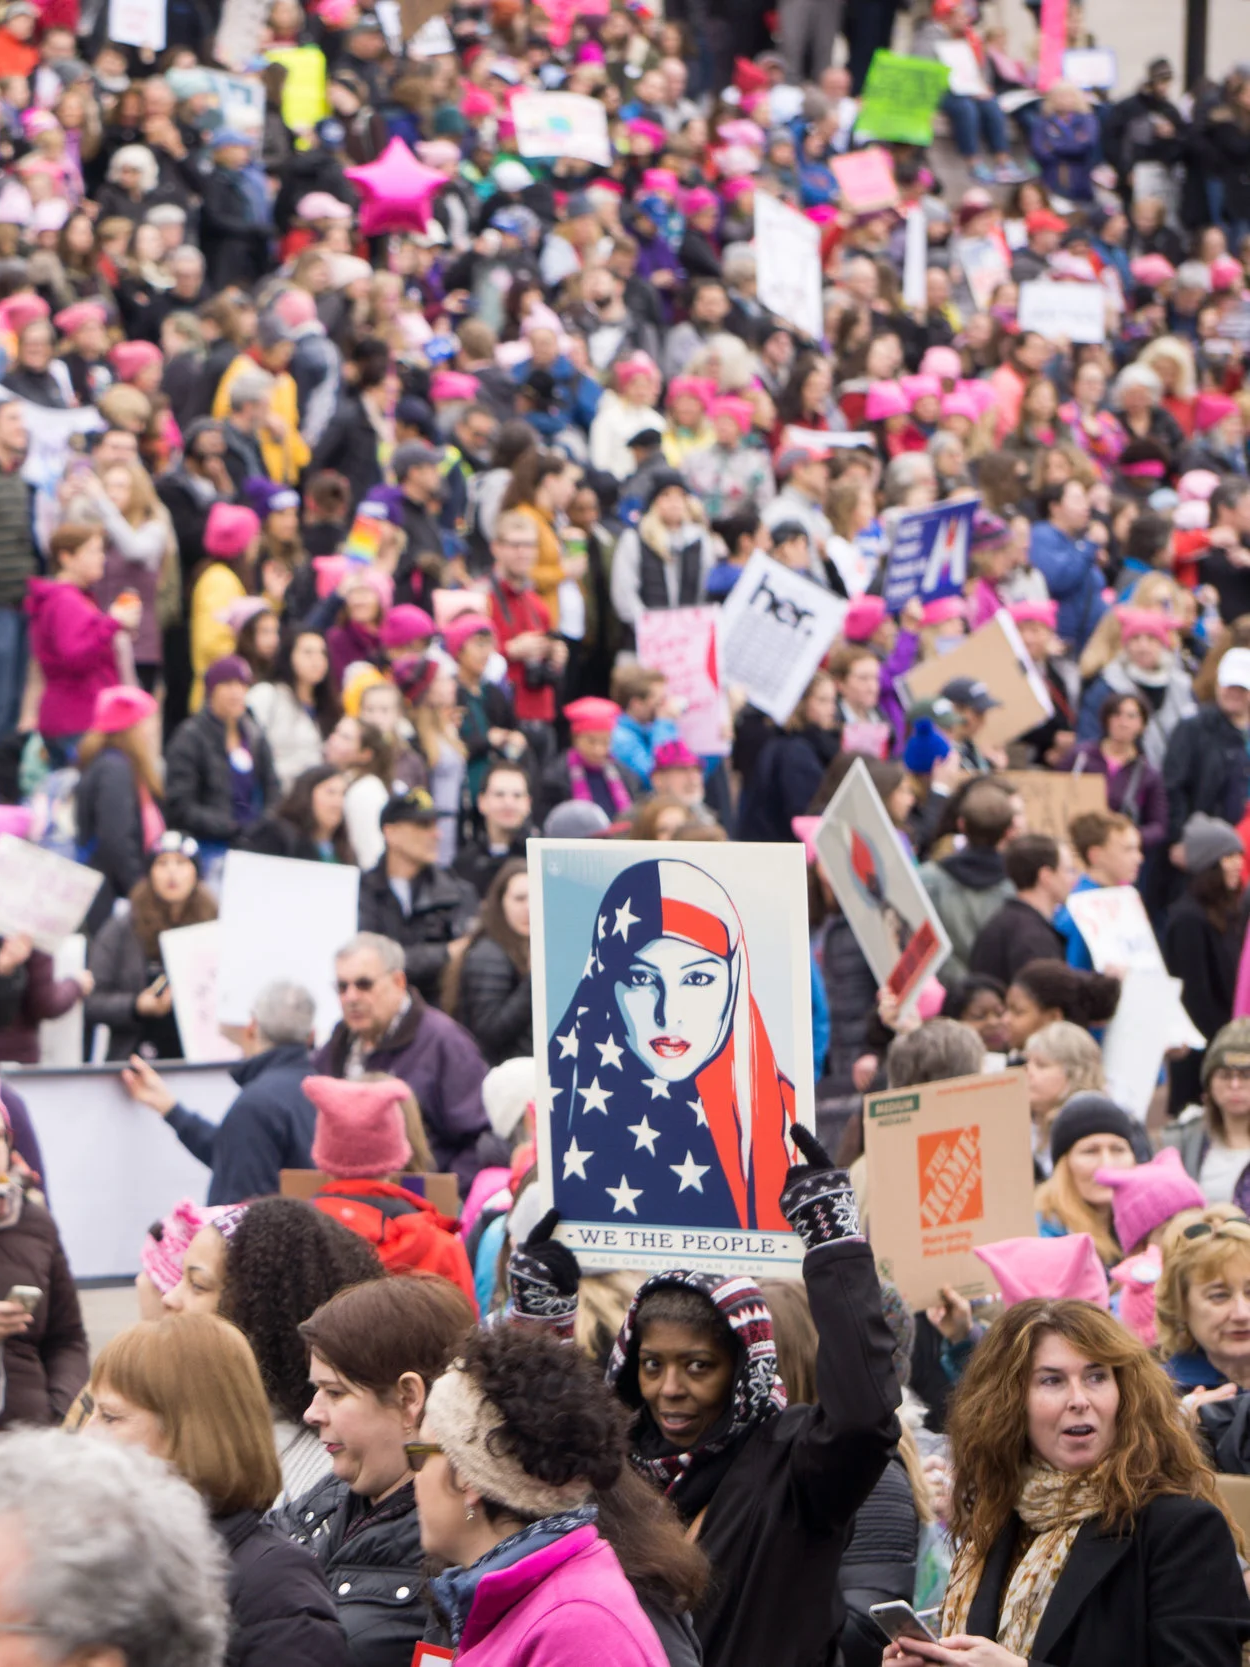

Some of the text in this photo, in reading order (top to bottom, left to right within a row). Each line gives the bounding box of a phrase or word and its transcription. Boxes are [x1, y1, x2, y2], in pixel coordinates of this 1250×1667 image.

[921, 1126, 980, 1225] HOME
[924, 1140, 951, 1180] THE
[578, 1229, 776, 1254] WE THE PEOPLE
[590, 1257, 765, 1273] ARE GREATER THAN FEAR
